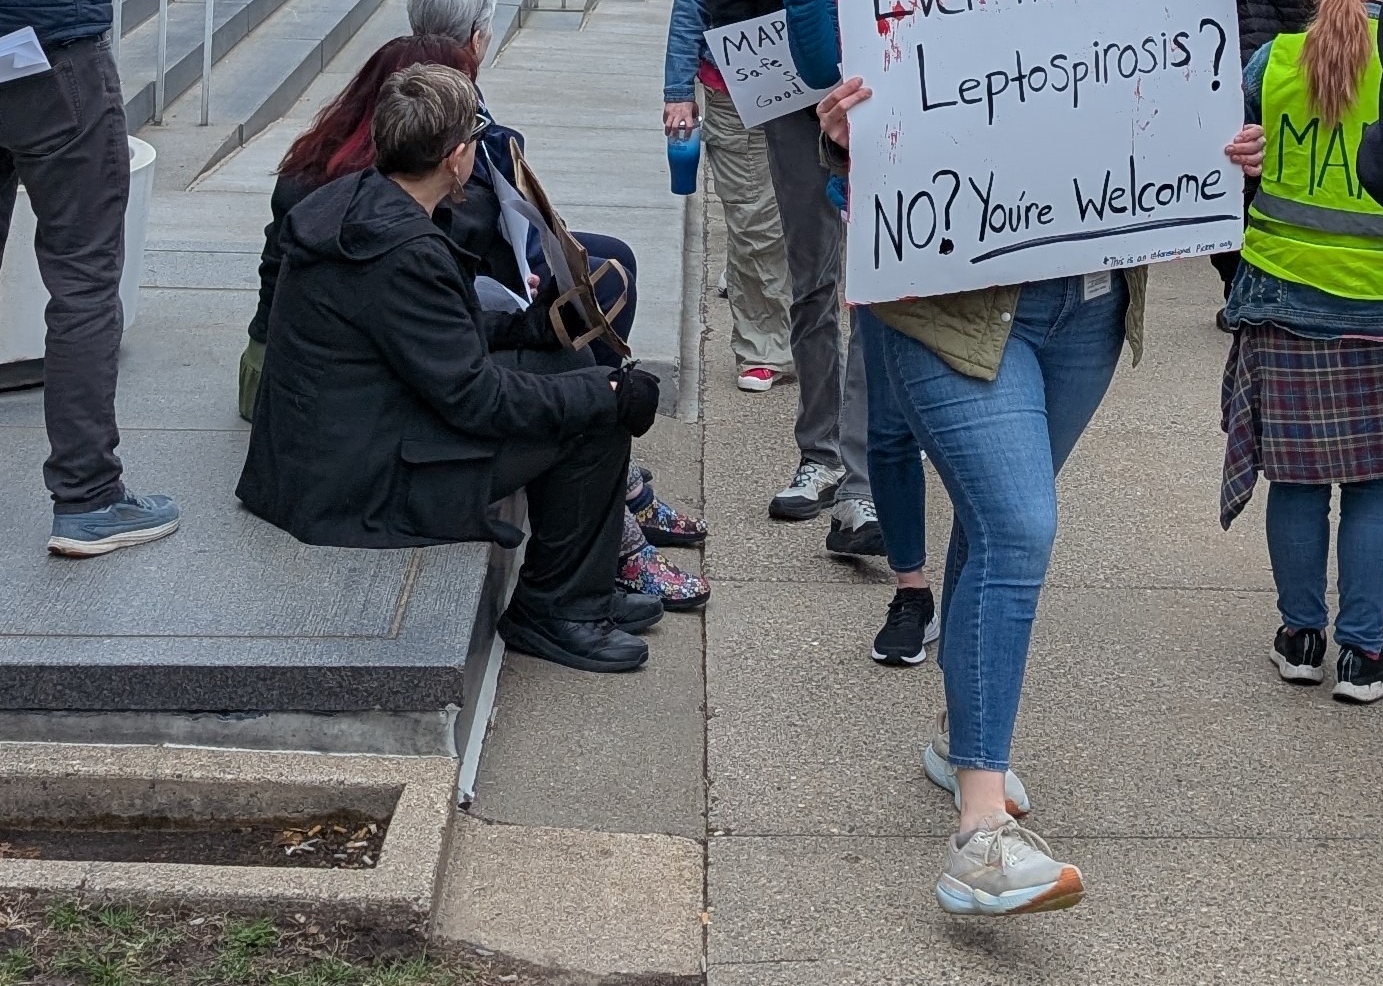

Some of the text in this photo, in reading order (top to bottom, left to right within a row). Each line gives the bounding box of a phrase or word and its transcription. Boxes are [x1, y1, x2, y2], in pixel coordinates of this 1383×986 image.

[722, 20, 786, 67] MAP
[1277, 113, 1369, 200] MA
[874, 169, 961, 270] NO?
[1073, 155, 1227, 224] Welcome
